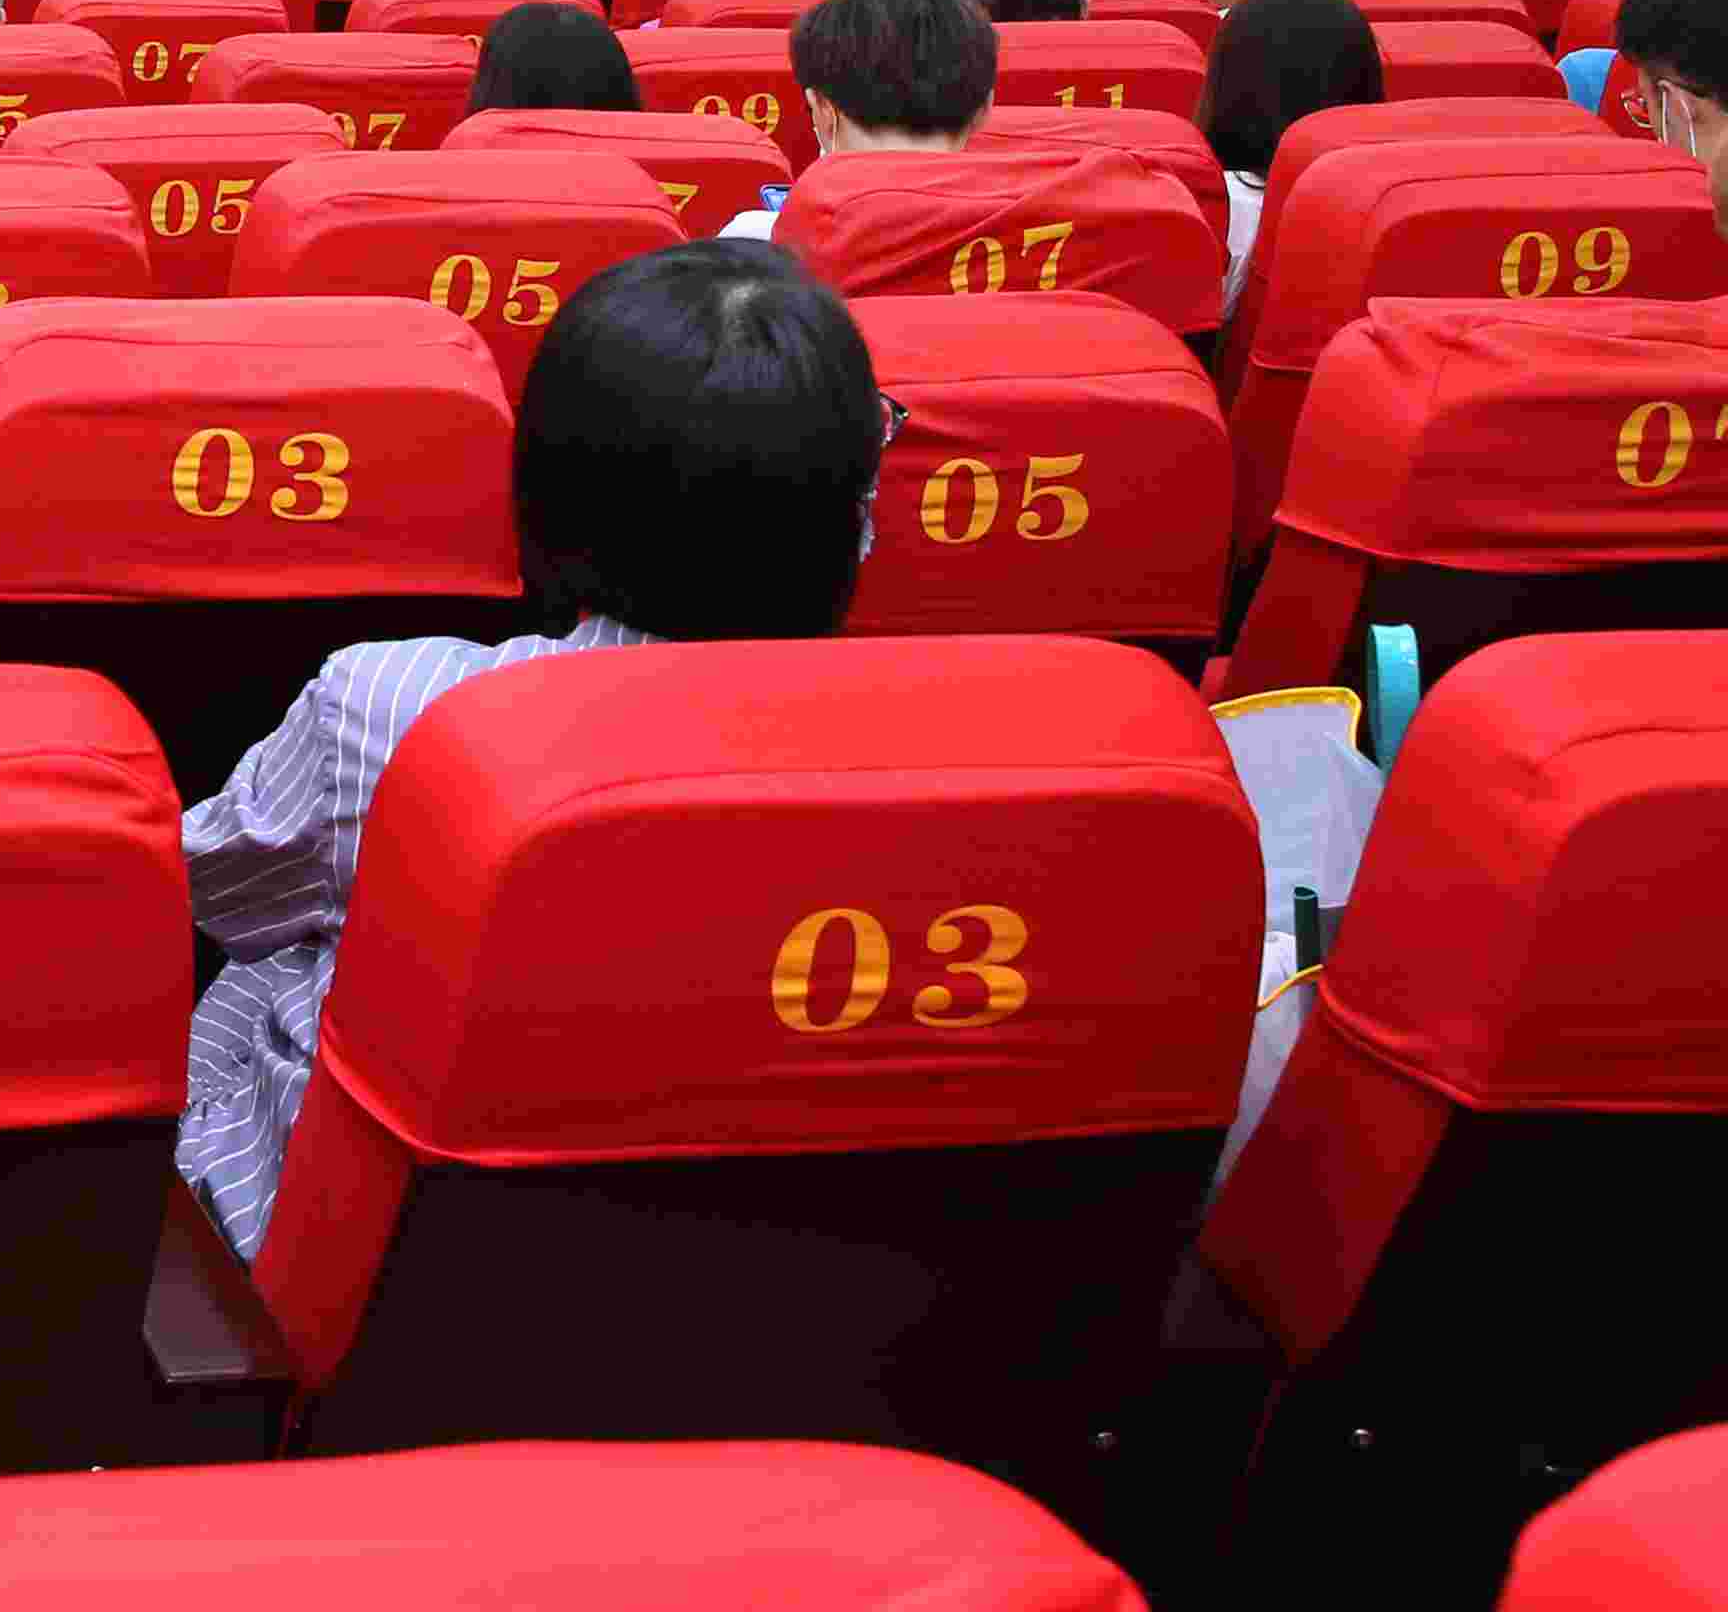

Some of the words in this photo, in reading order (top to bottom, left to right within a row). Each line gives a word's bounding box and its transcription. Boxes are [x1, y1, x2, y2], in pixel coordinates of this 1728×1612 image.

[132, 41, 217, 84] 07
[149, 178, 257, 237] 05
[428, 253, 562, 326] 05
[949, 220, 1073, 294] 07
[1500, 226, 1631, 300] 09
[170, 426, 352, 522] 03
[919, 452, 1090, 544] 05
[771, 903, 1030, 1033] 03
